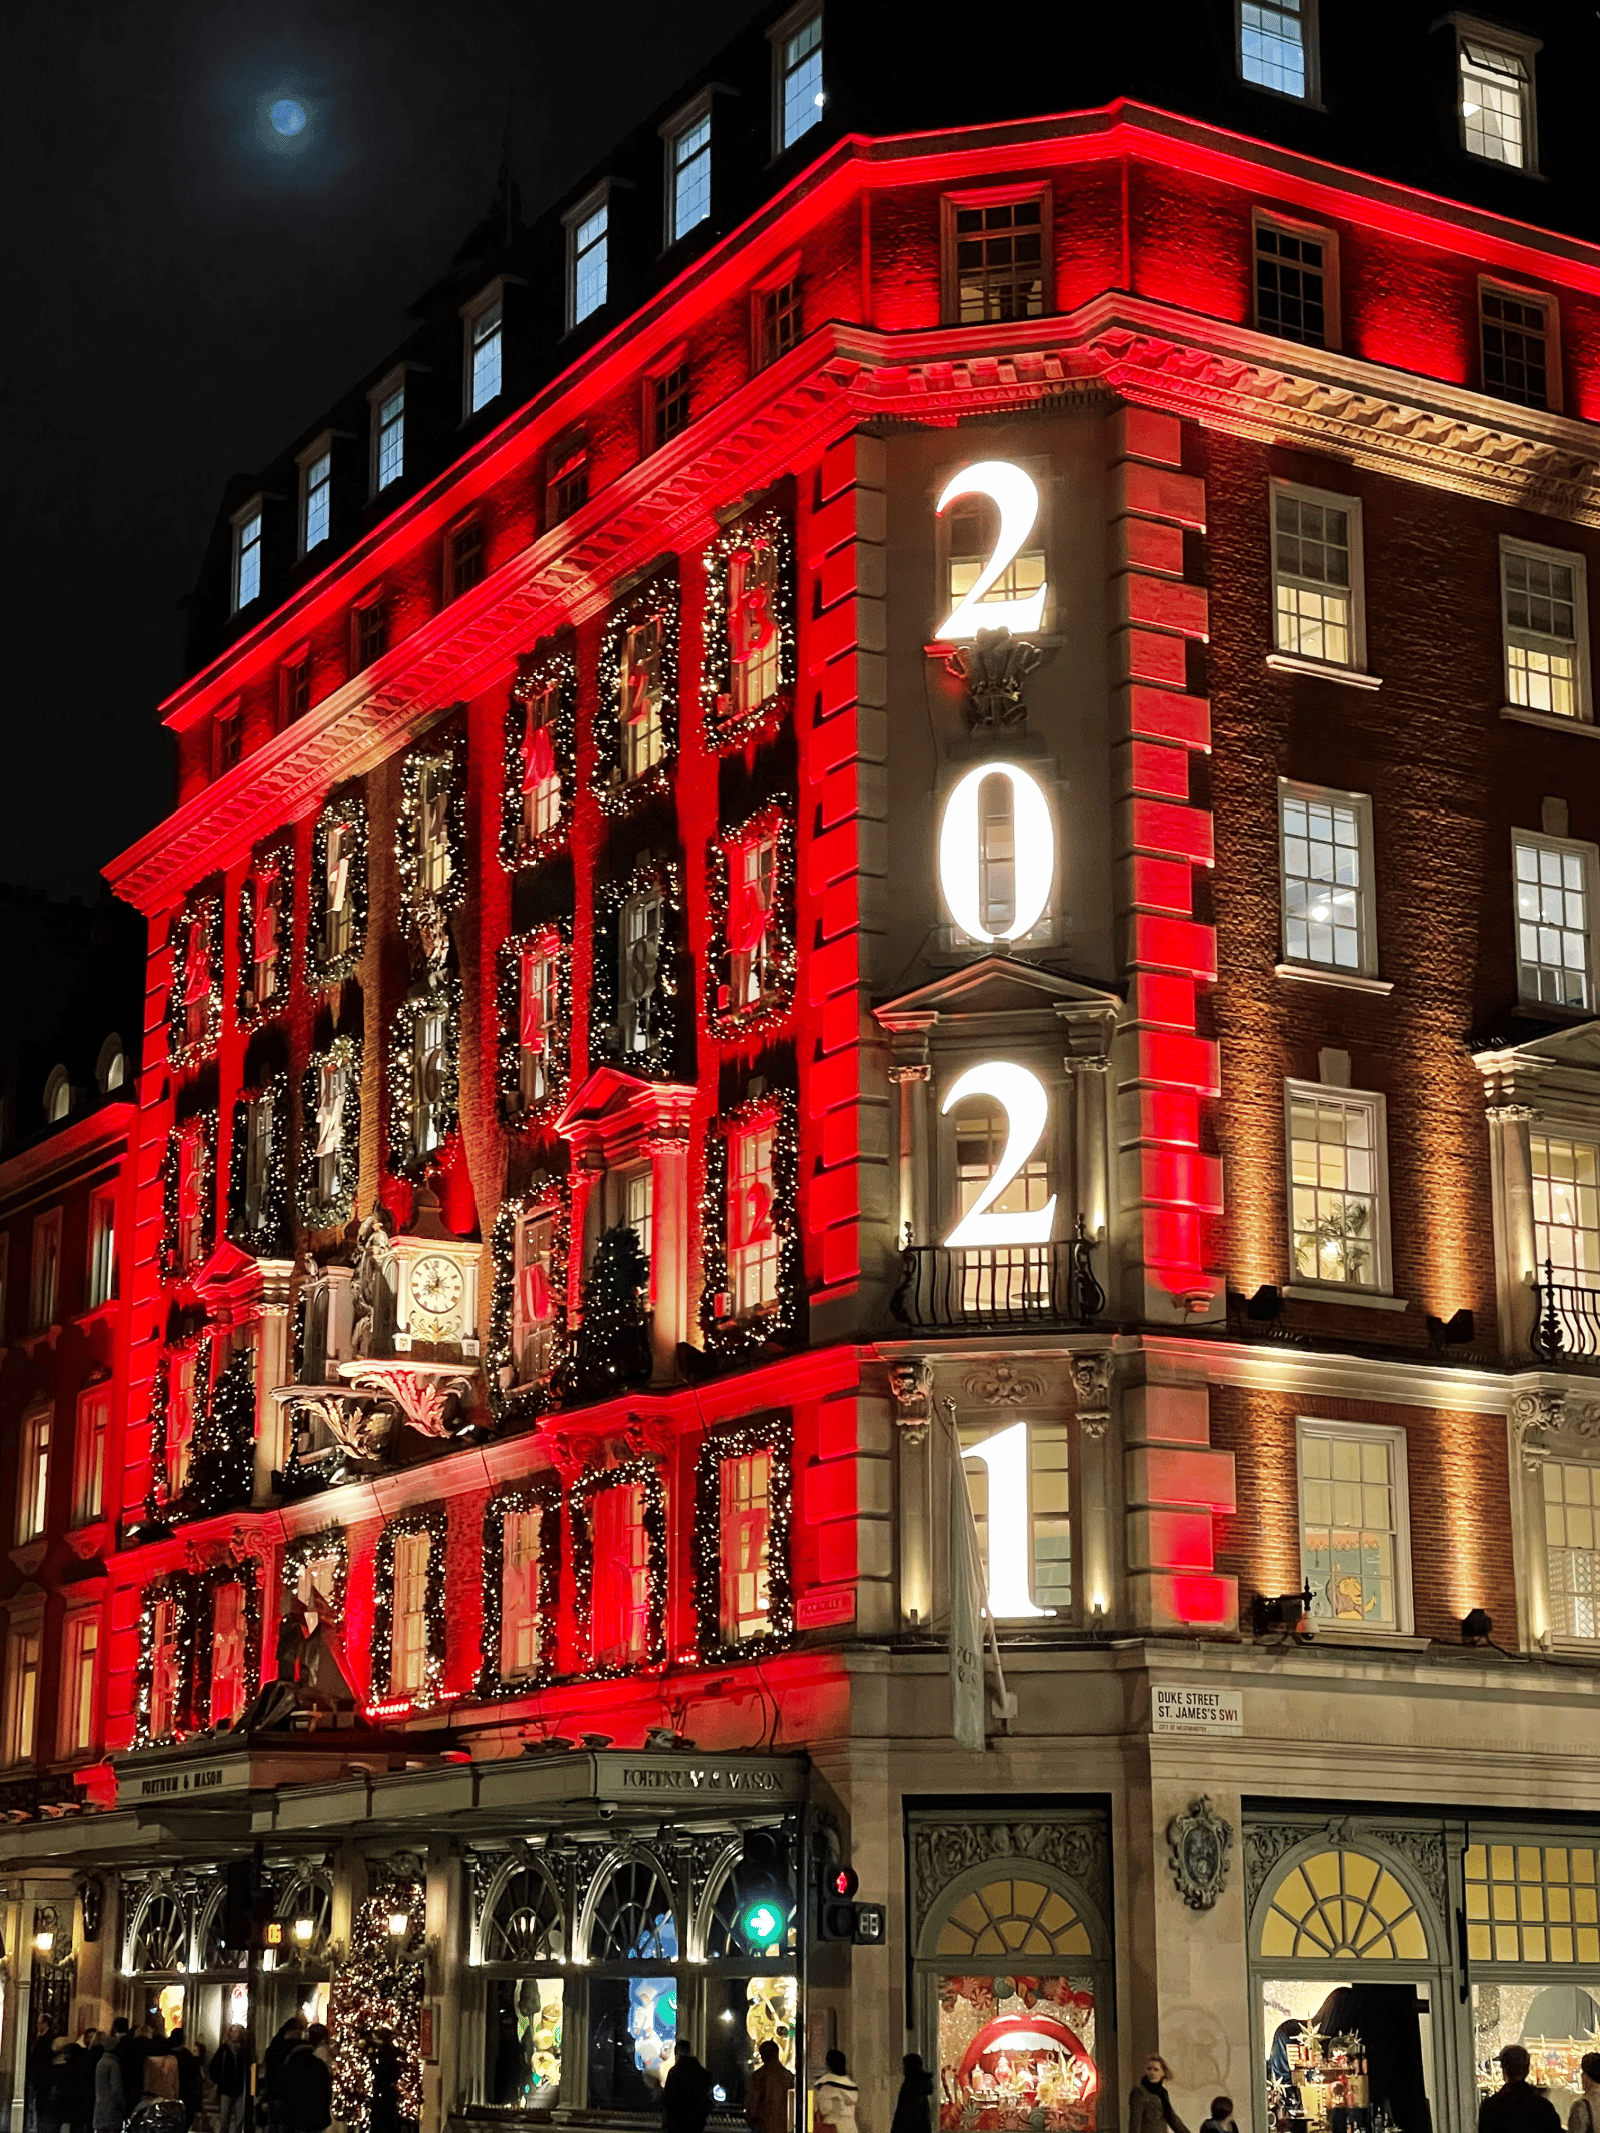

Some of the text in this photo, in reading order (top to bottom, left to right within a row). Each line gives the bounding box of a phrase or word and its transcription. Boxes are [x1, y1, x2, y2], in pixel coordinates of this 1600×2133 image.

[1158, 1691, 1219, 1706] DUKE STREET
[1159, 1706, 1237, 1721] ST. JAMES'S SW1
[142, 1777, 178, 1795] FORTNUM
[194, 1770, 222, 1787] MASON
[729, 1772, 783, 1791] MASON
